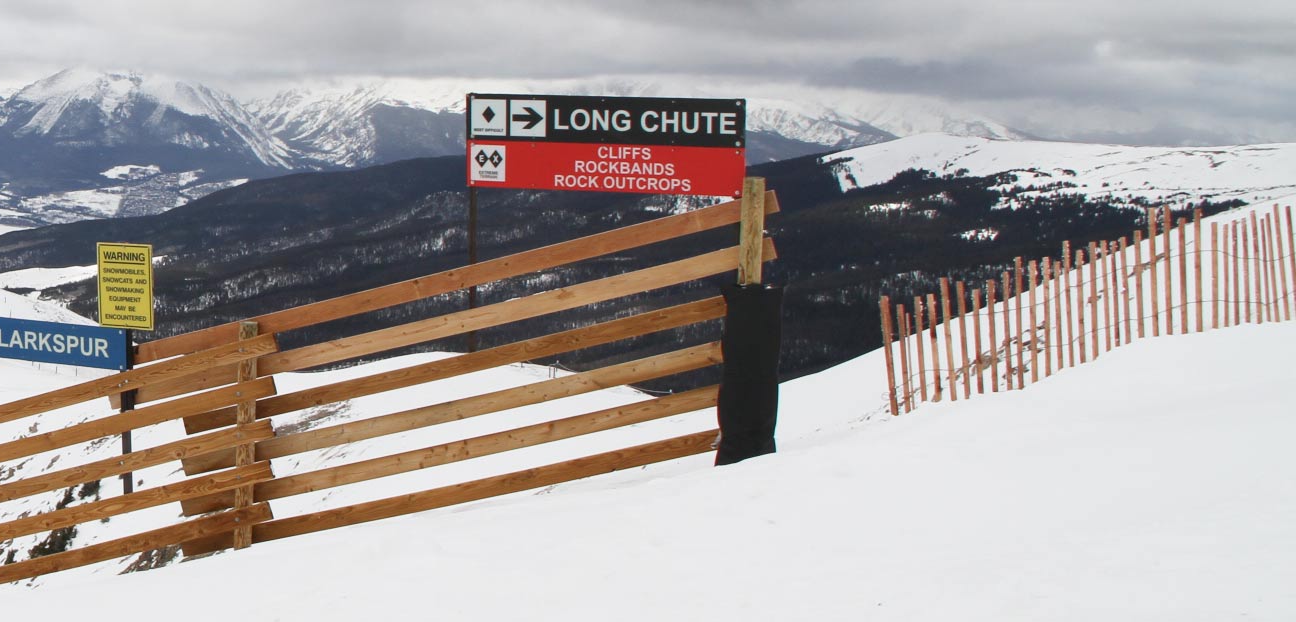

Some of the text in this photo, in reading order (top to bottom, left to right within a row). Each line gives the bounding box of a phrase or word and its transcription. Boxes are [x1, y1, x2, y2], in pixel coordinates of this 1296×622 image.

[554, 108, 737, 134] LONG CHUTE
[478, 154, 499, 163] E X
[597, 146, 651, 160] CLIFFS
[574, 160, 675, 176] ROCKBANDS
[554, 174, 691, 192] ROCK OUTCROPS
[103, 251, 146, 262] WARNING
